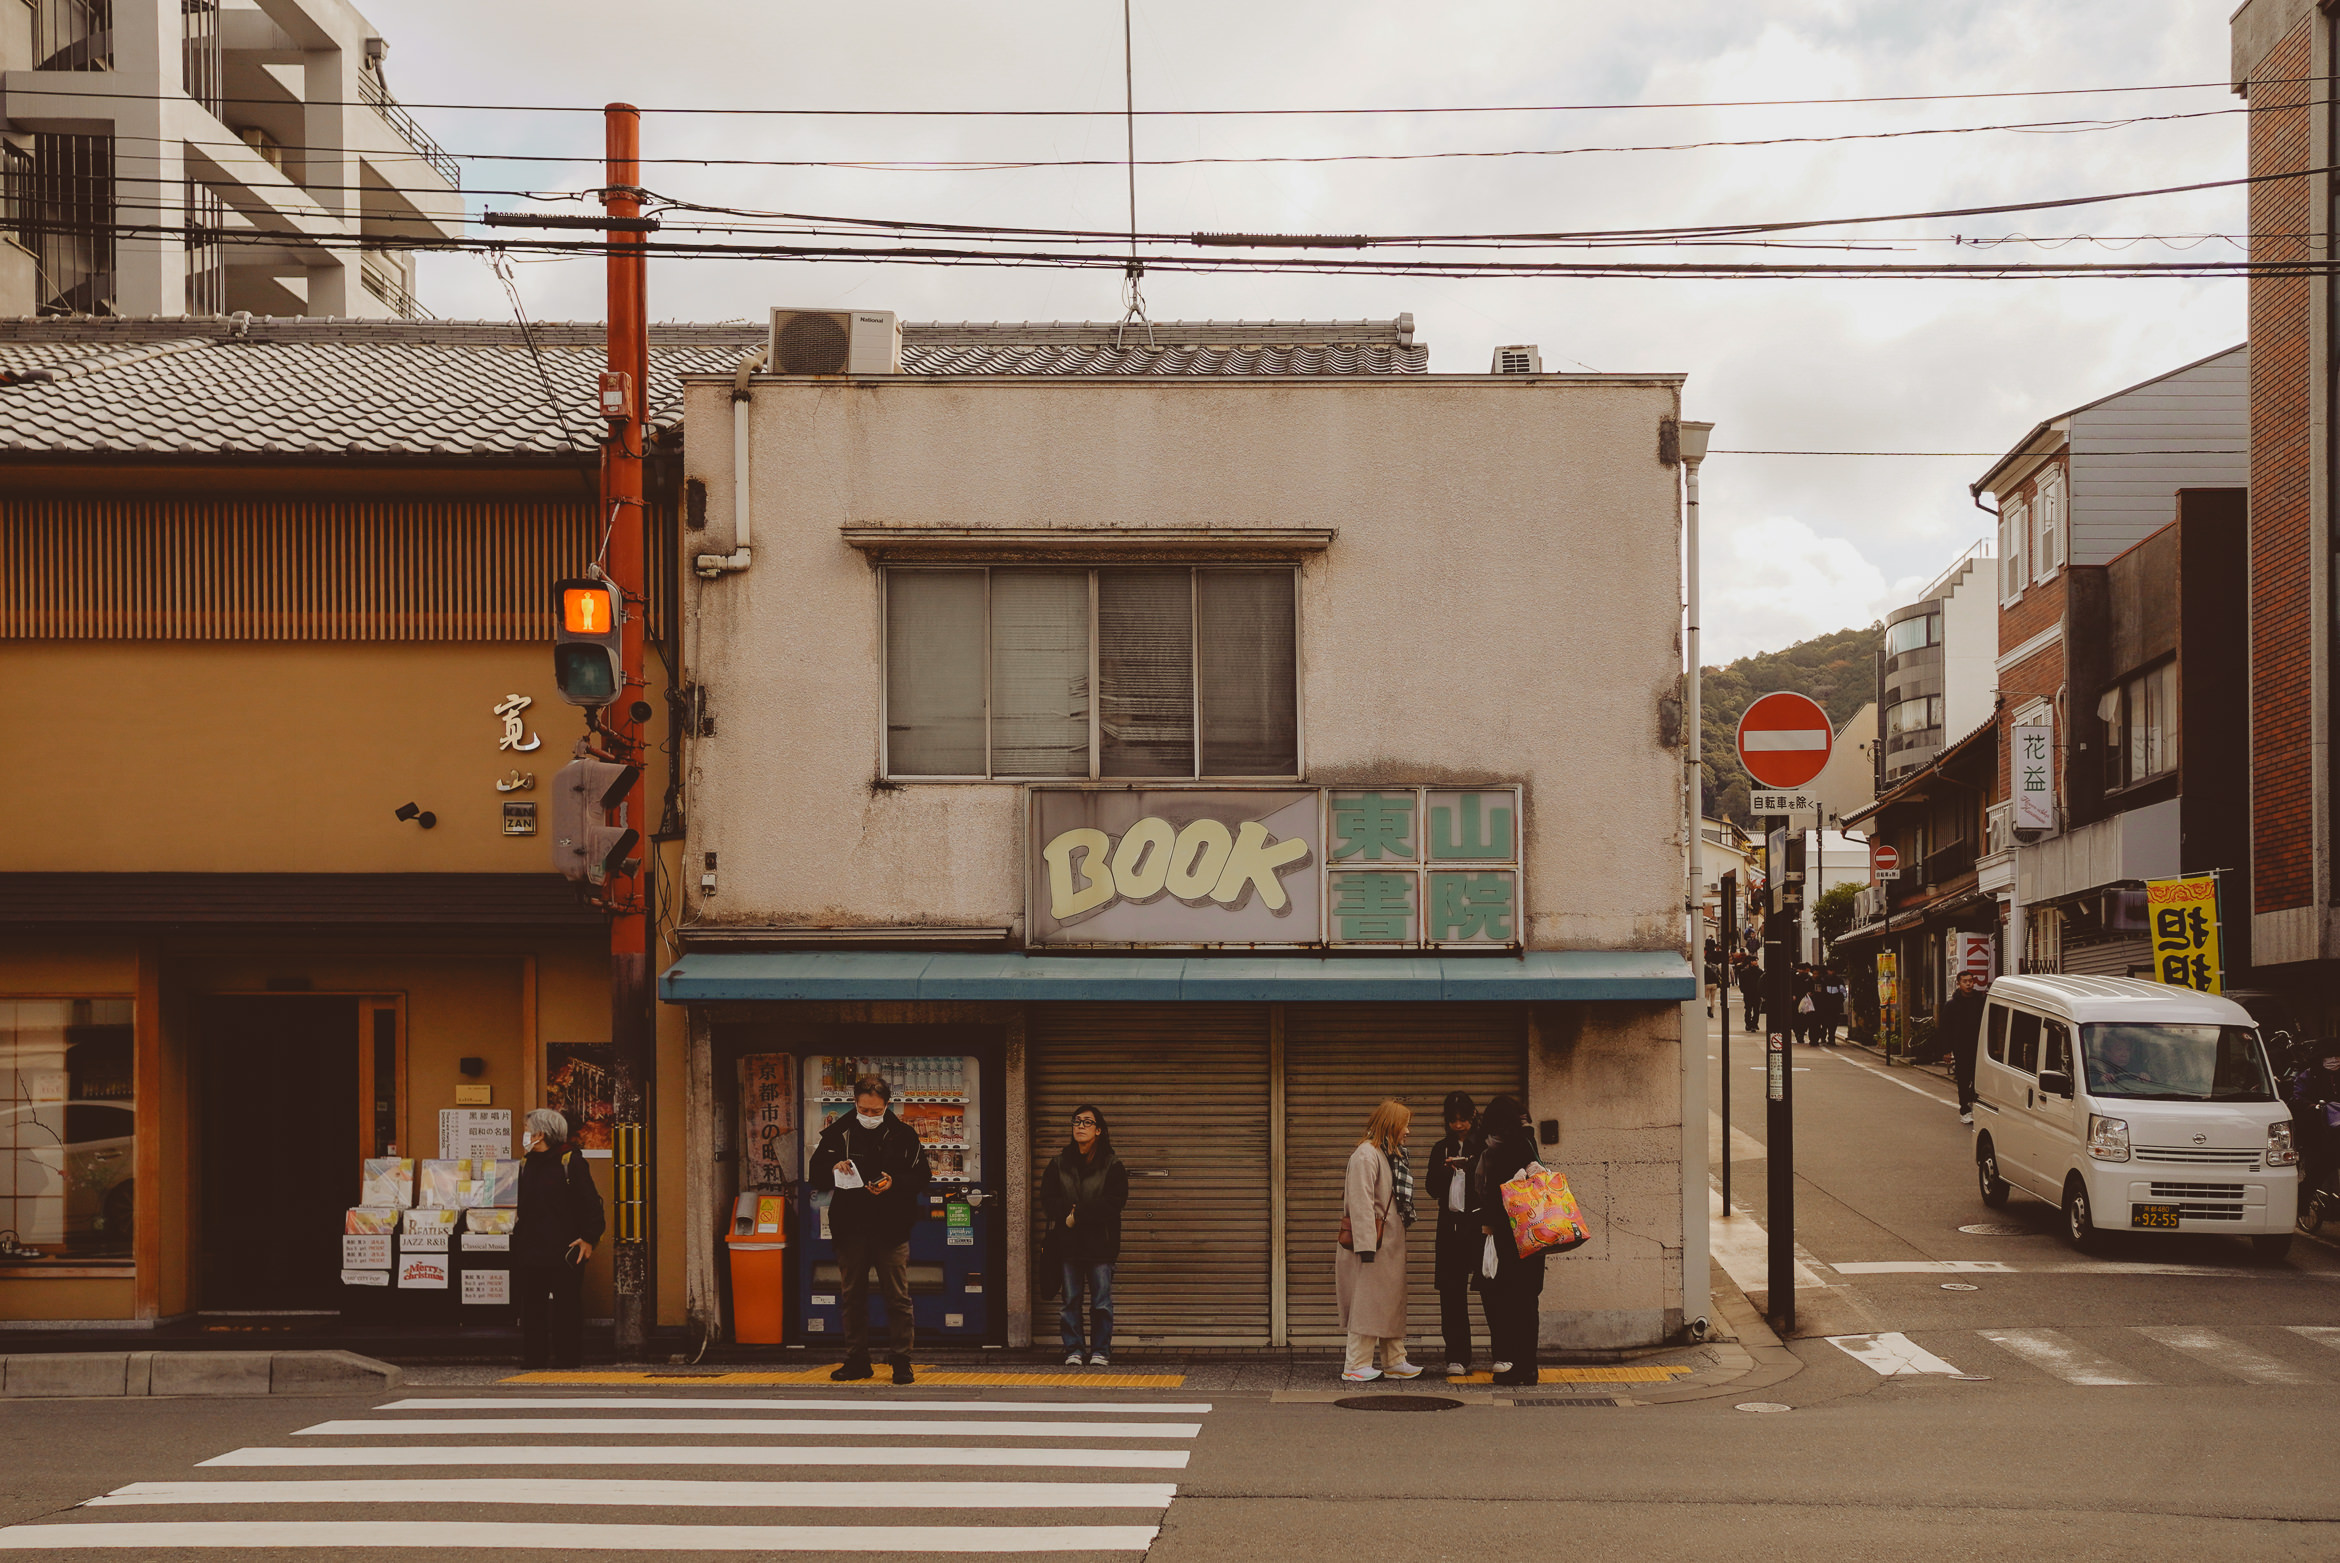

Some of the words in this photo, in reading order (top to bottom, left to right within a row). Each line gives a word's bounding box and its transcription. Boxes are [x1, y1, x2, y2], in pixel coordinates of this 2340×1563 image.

[2023, 733, 2047, 793] 花益
[1753, 795, 1815, 810] 自転車を除く
[506, 807, 532, 817] KAN
[507, 818, 532, 828] ZAN
[1331, 792, 1511, 860] 東山
[1042, 816, 1311, 922] BOOK
[1331, 873, 1511, 941] 書院
[469, 1128, 510, 1136] 昭和の名盤
[2142, 1213, 2177, 1226] 92-55
[402, 1238, 424, 1246] JAZZ
[426, 1238, 446, 1246] R&B
[409, 1263, 439, 1273] Merry
[403, 1272, 445, 1281] christmas
